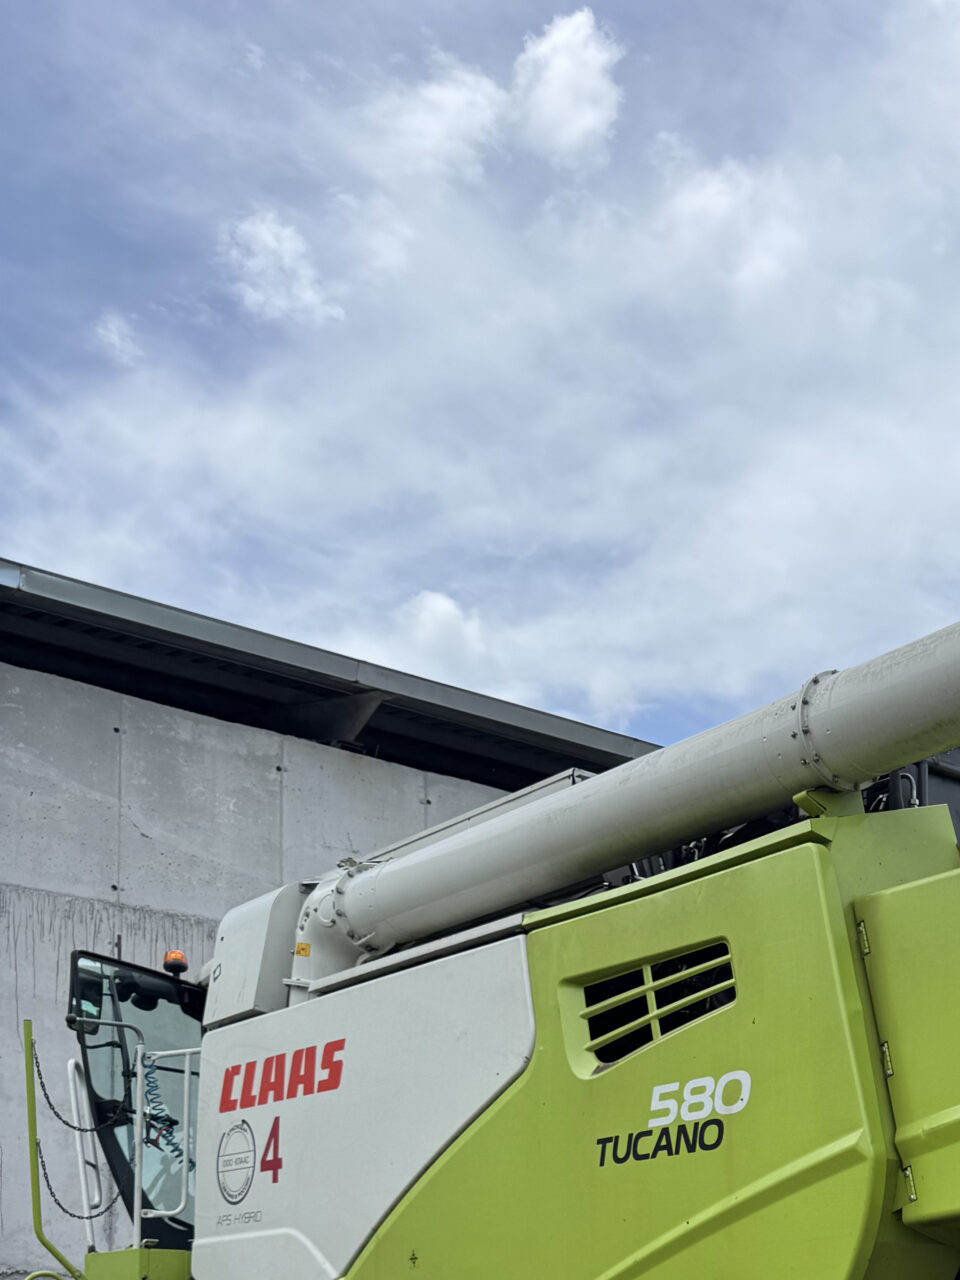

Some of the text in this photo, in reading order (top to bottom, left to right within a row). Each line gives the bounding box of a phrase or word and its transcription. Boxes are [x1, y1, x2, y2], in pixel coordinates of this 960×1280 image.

[219, 1038, 346, 1113] CLAAS
[648, 1070, 751, 1128] 580
[260, 1116, 283, 1184] 4
[597, 1118, 724, 1167] TUCANO
[216, 1210, 263, 1227] APS HYBRID
